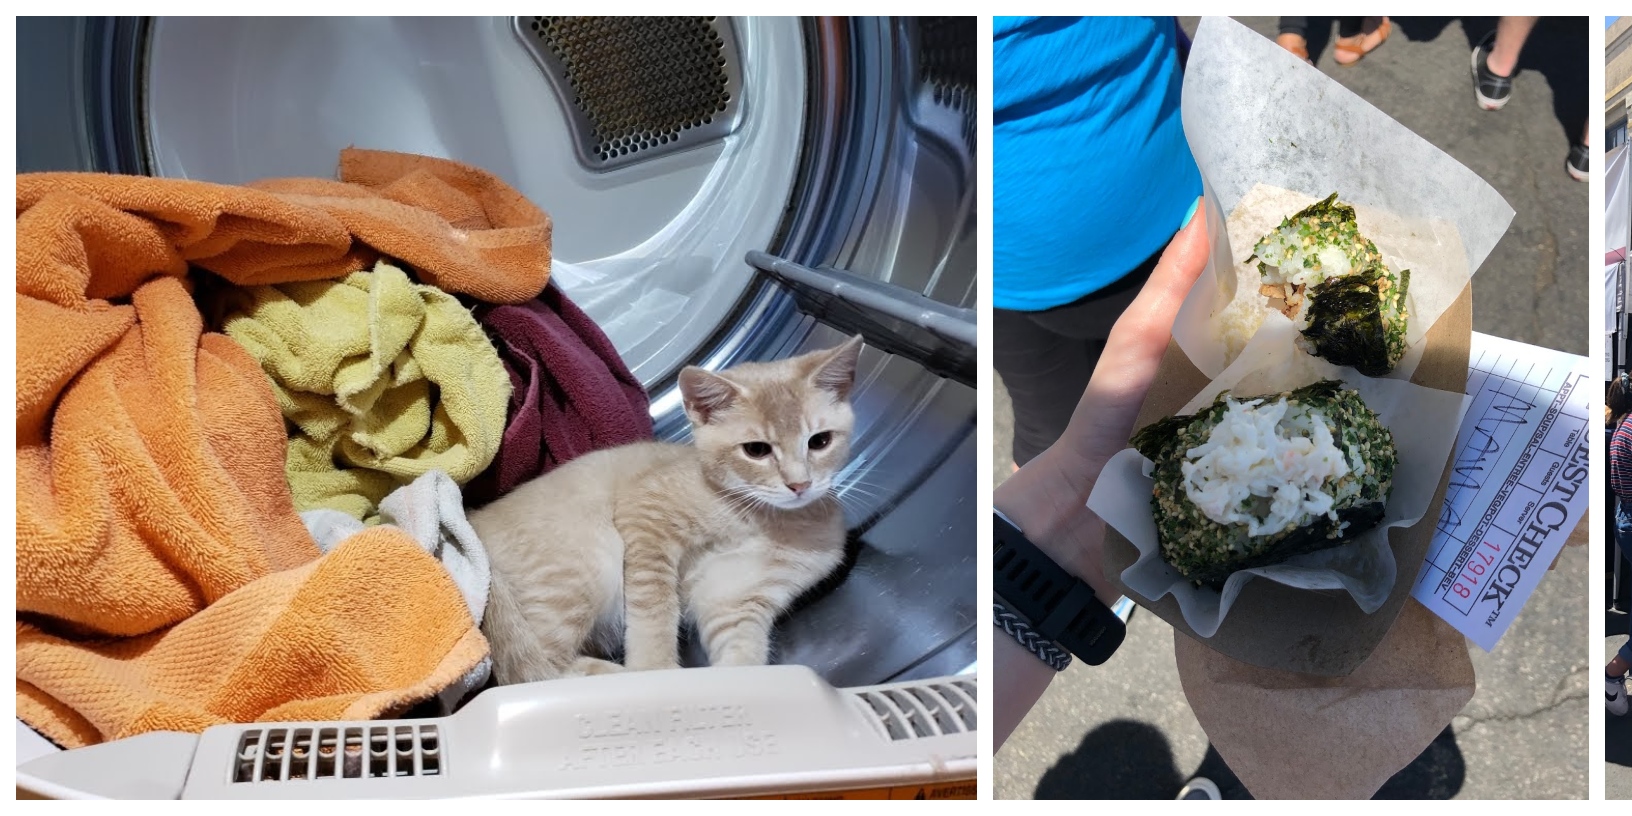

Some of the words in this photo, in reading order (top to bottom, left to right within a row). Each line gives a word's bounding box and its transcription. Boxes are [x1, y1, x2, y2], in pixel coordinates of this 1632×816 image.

[1564, 428, 1581, 448] Table
[1540, 461, 1561, 487] Guests
[1516, 500, 1536, 524] Server
[1453, 540, 1501, 599] 17918
[573, 707, 667, 740] CLEAN
[670, 702, 755, 733] FILTER
[557, 740, 646, 770] AFTER
[652, 736, 722, 764] EACH
[733, 730, 779, 758] USE
